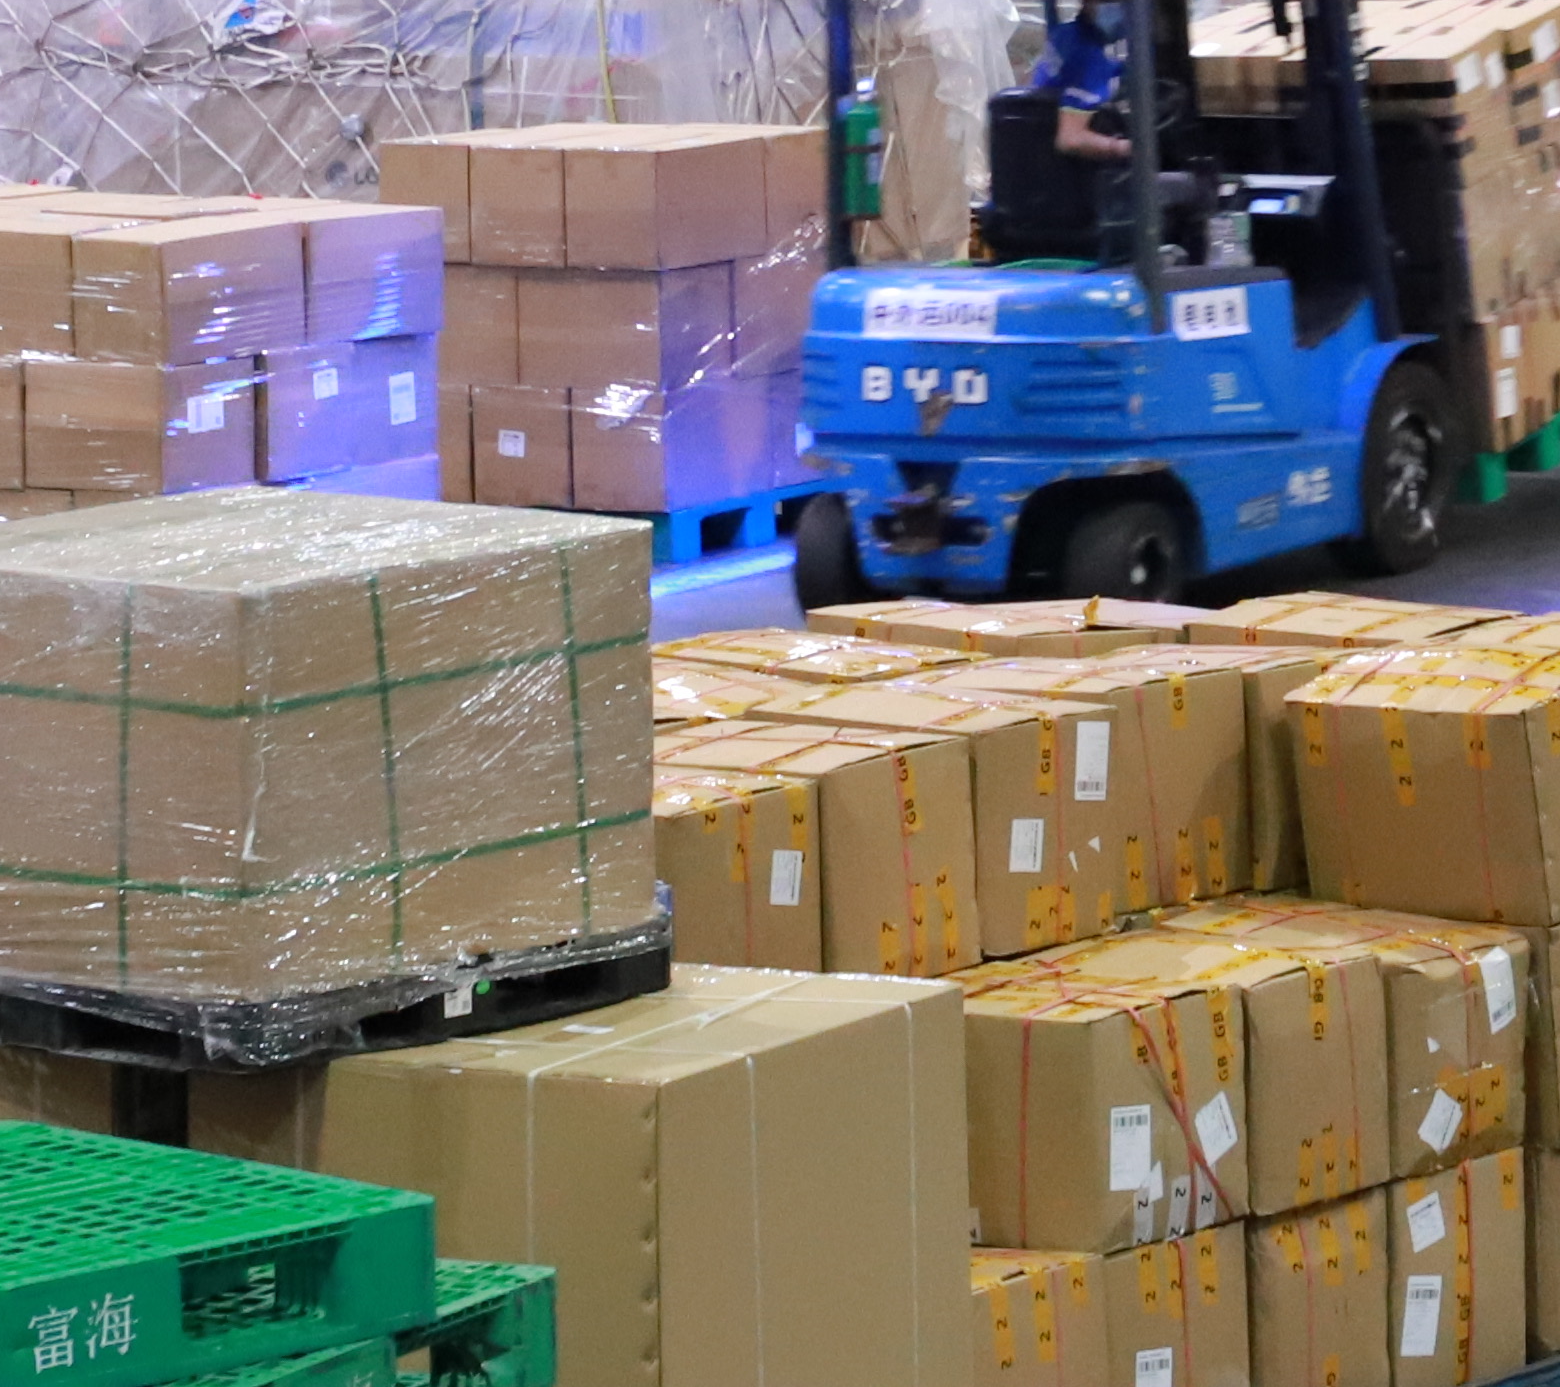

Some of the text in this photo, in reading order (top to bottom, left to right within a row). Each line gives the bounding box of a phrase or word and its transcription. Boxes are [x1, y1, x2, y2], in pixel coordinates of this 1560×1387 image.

[861, 364, 989, 405] BYD
[1173, 687, 1184, 711] GB
[1041, 749, 1052, 773] GB
[1217, 1056, 1229, 1081] GB
[26, 1291, 140, 1375] 富海
